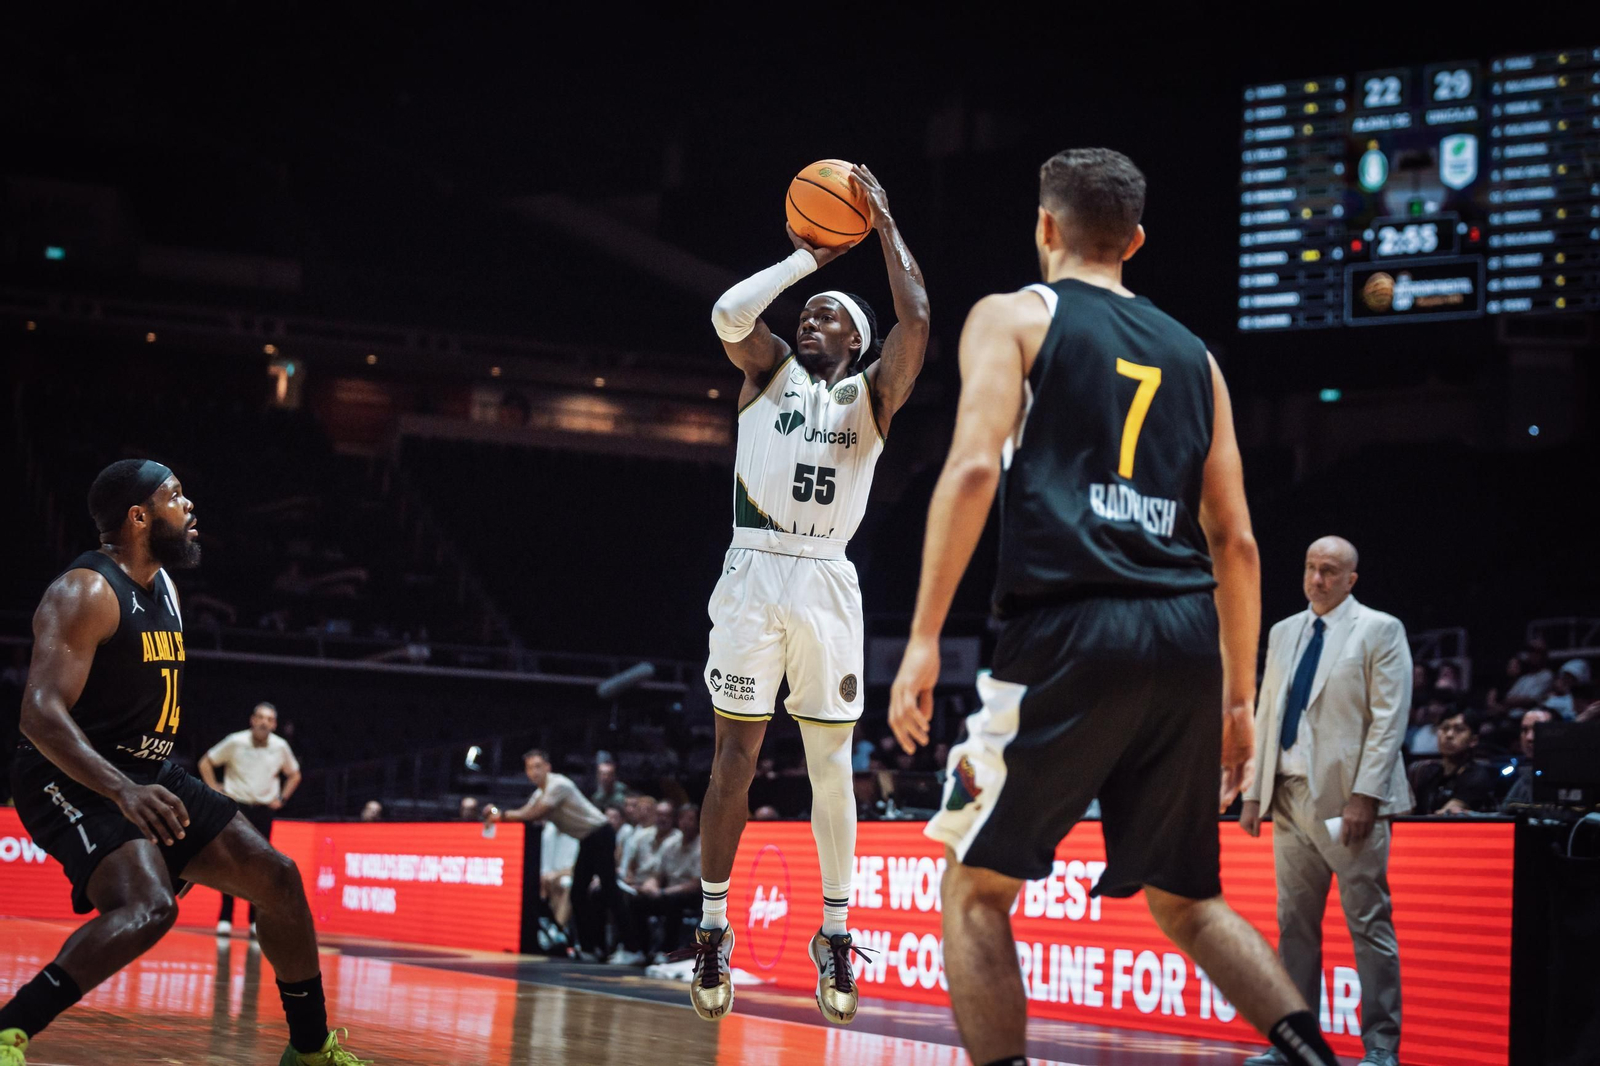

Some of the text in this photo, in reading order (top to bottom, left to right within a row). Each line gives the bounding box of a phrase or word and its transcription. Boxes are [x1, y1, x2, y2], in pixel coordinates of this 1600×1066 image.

[1364, 76, 1401, 108] 22
[1433, 69, 1472, 101] 29
[1116, 357, 1162, 480] 7
[804, 426, 857, 449] Unicaja
[792, 462, 836, 505] 55
[174, 631, 186, 662] S
[724, 682, 756, 694] DEL SOL
[726, 673, 756, 686] COSTA
[848, 855, 884, 909] HE
[1024, 859, 1107, 922] BEST
[1111, 949, 1187, 1017] FOR
